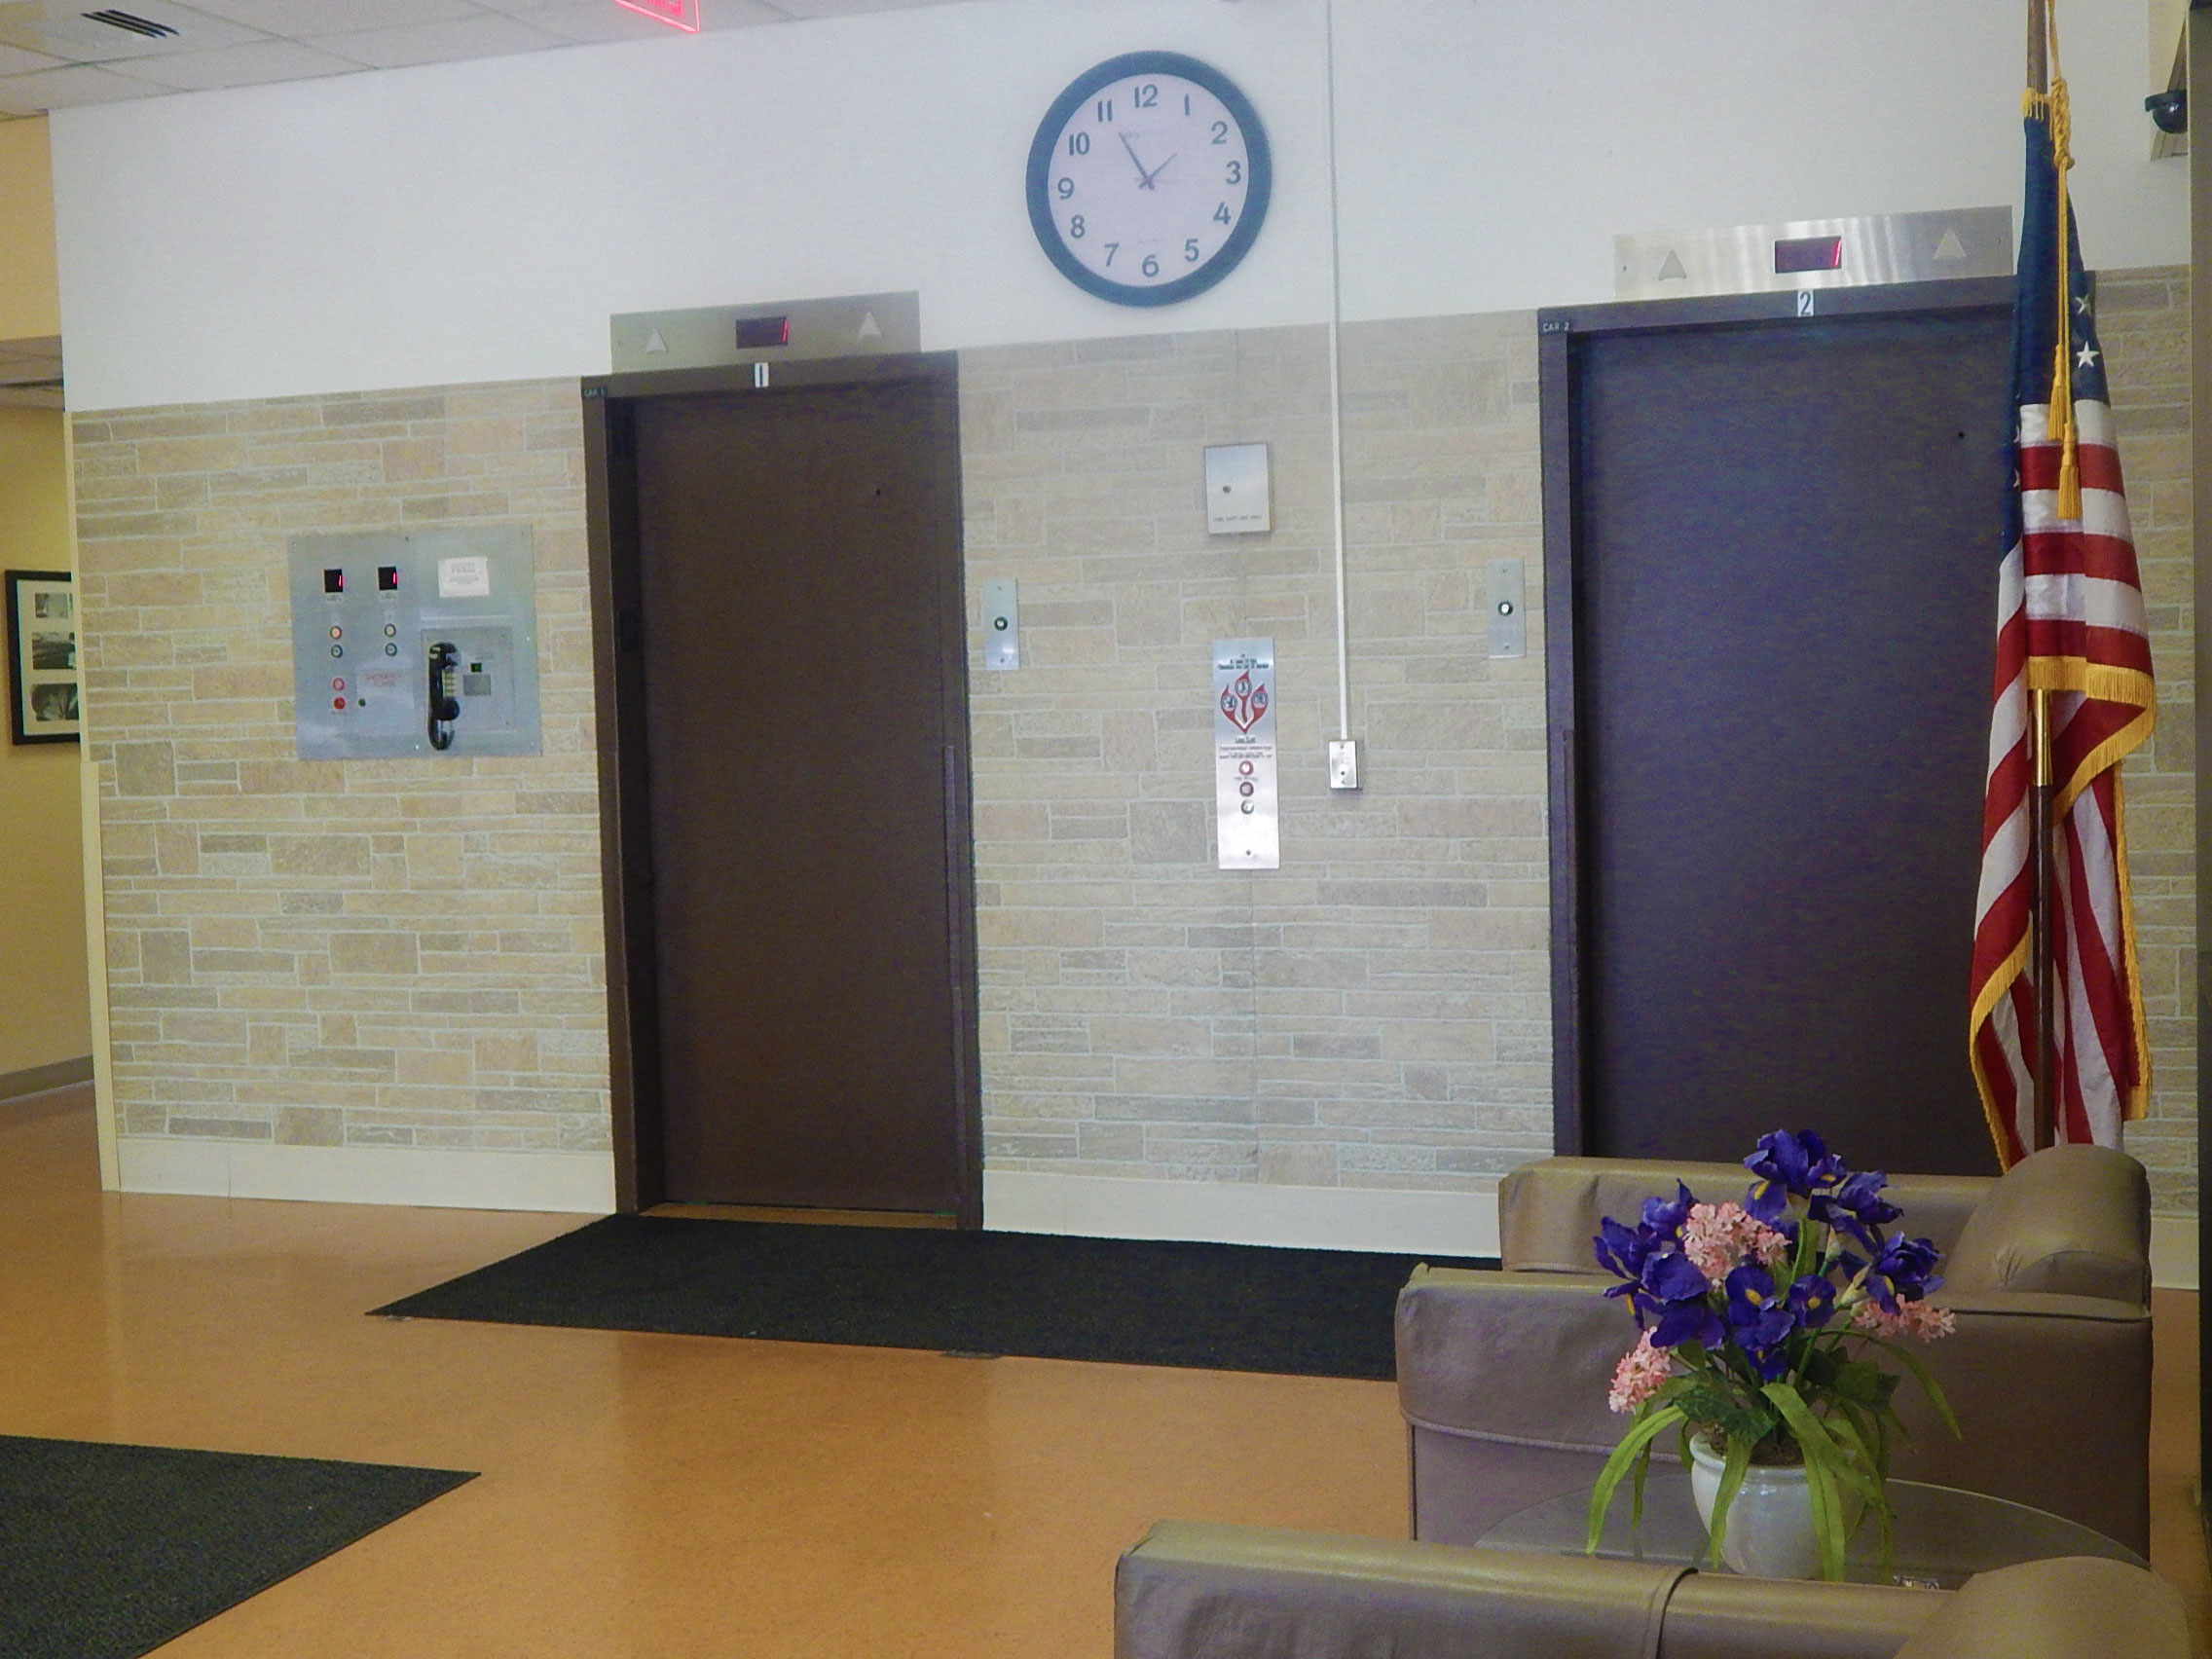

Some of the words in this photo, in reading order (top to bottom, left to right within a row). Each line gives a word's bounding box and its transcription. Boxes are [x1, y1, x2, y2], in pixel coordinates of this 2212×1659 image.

[1133, 84, 1159, 108] 12
[1183, 92, 1191, 116] 1
[1096, 98, 1113, 123] 11
[1068, 131, 1090, 156] 10
[1210, 120, 1229, 145] 2
[1225, 160, 1241, 185] 3
[1057, 177, 1075, 201] 9
[1212, 201, 1232, 225] 4
[1070, 214, 1086, 240] 8
[1104, 242, 1120, 267] 7
[1184, 238, 1199, 262] 5
[1141, 254, 1160, 277] 6
[1799, 291, 1812, 316] 2
[1542, 321, 1560, 332] CAR
[1564, 321, 1569, 331] 2
